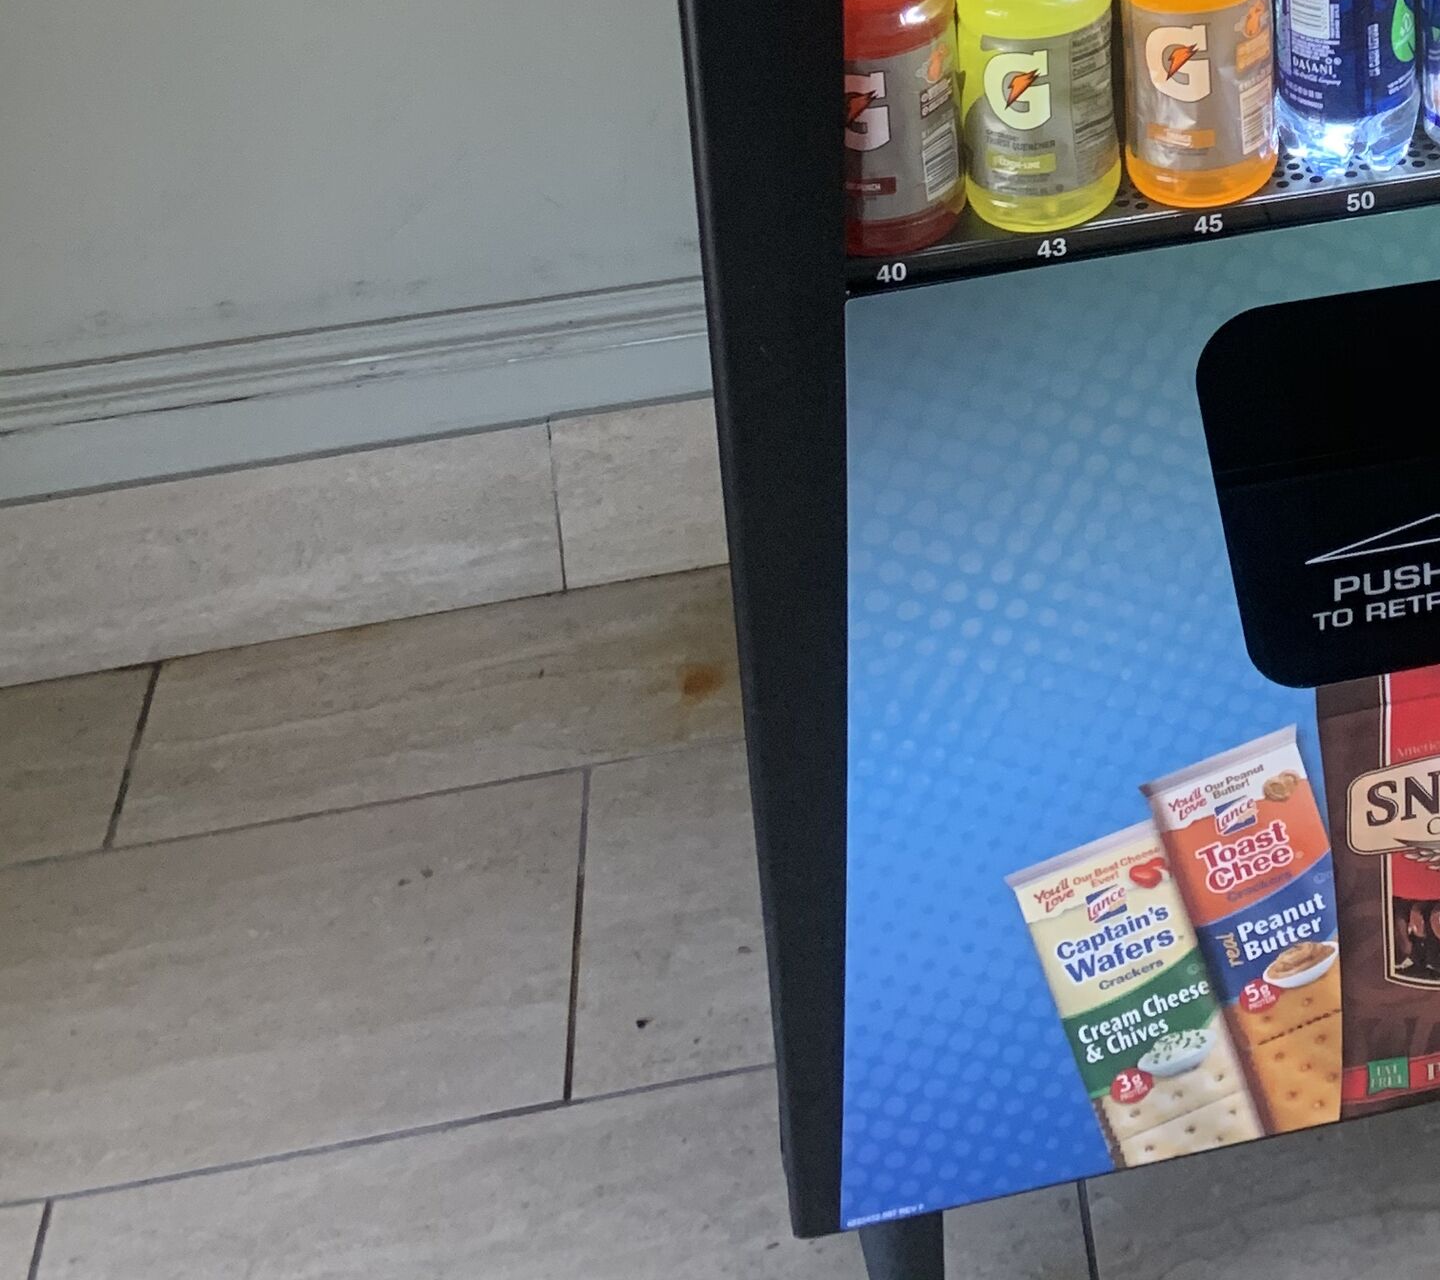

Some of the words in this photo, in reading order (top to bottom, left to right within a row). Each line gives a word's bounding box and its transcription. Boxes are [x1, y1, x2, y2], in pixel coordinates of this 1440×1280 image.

[1145, 24, 1213, 103] G
[1292, 56, 1333, 75] DASANI
[983, 49, 1052, 131] G
[1346, 191, 1376, 211] 50
[1194, 213, 1224, 235] 45
[1036, 237, 1068, 259] 43
[876, 262, 907, 284] 40
[1313, 607, 1354, 631] TO
[1072, 873, 1093, 887] Our
[1094, 860, 1120, 877] Best
[1119, 846, 1160, 867] Cheese
[1198, 821, 1289, 868] Toast
[1208, 847, 1291, 891] Chee
[1056, 906, 1169, 960] Captain's
[1237, 893, 1327, 941] Peanut
[1244, 916, 1323, 962] Butter
[1064, 929, 1175, 983] Wafers
[1098, 958, 1165, 991] Crackers
[1077, 1007, 1142, 1044] Cream
[1142, 979, 1210, 1017] Cheese
[1085, 1043, 1105, 1064] &
[1106, 1018, 1169, 1055] Chives
